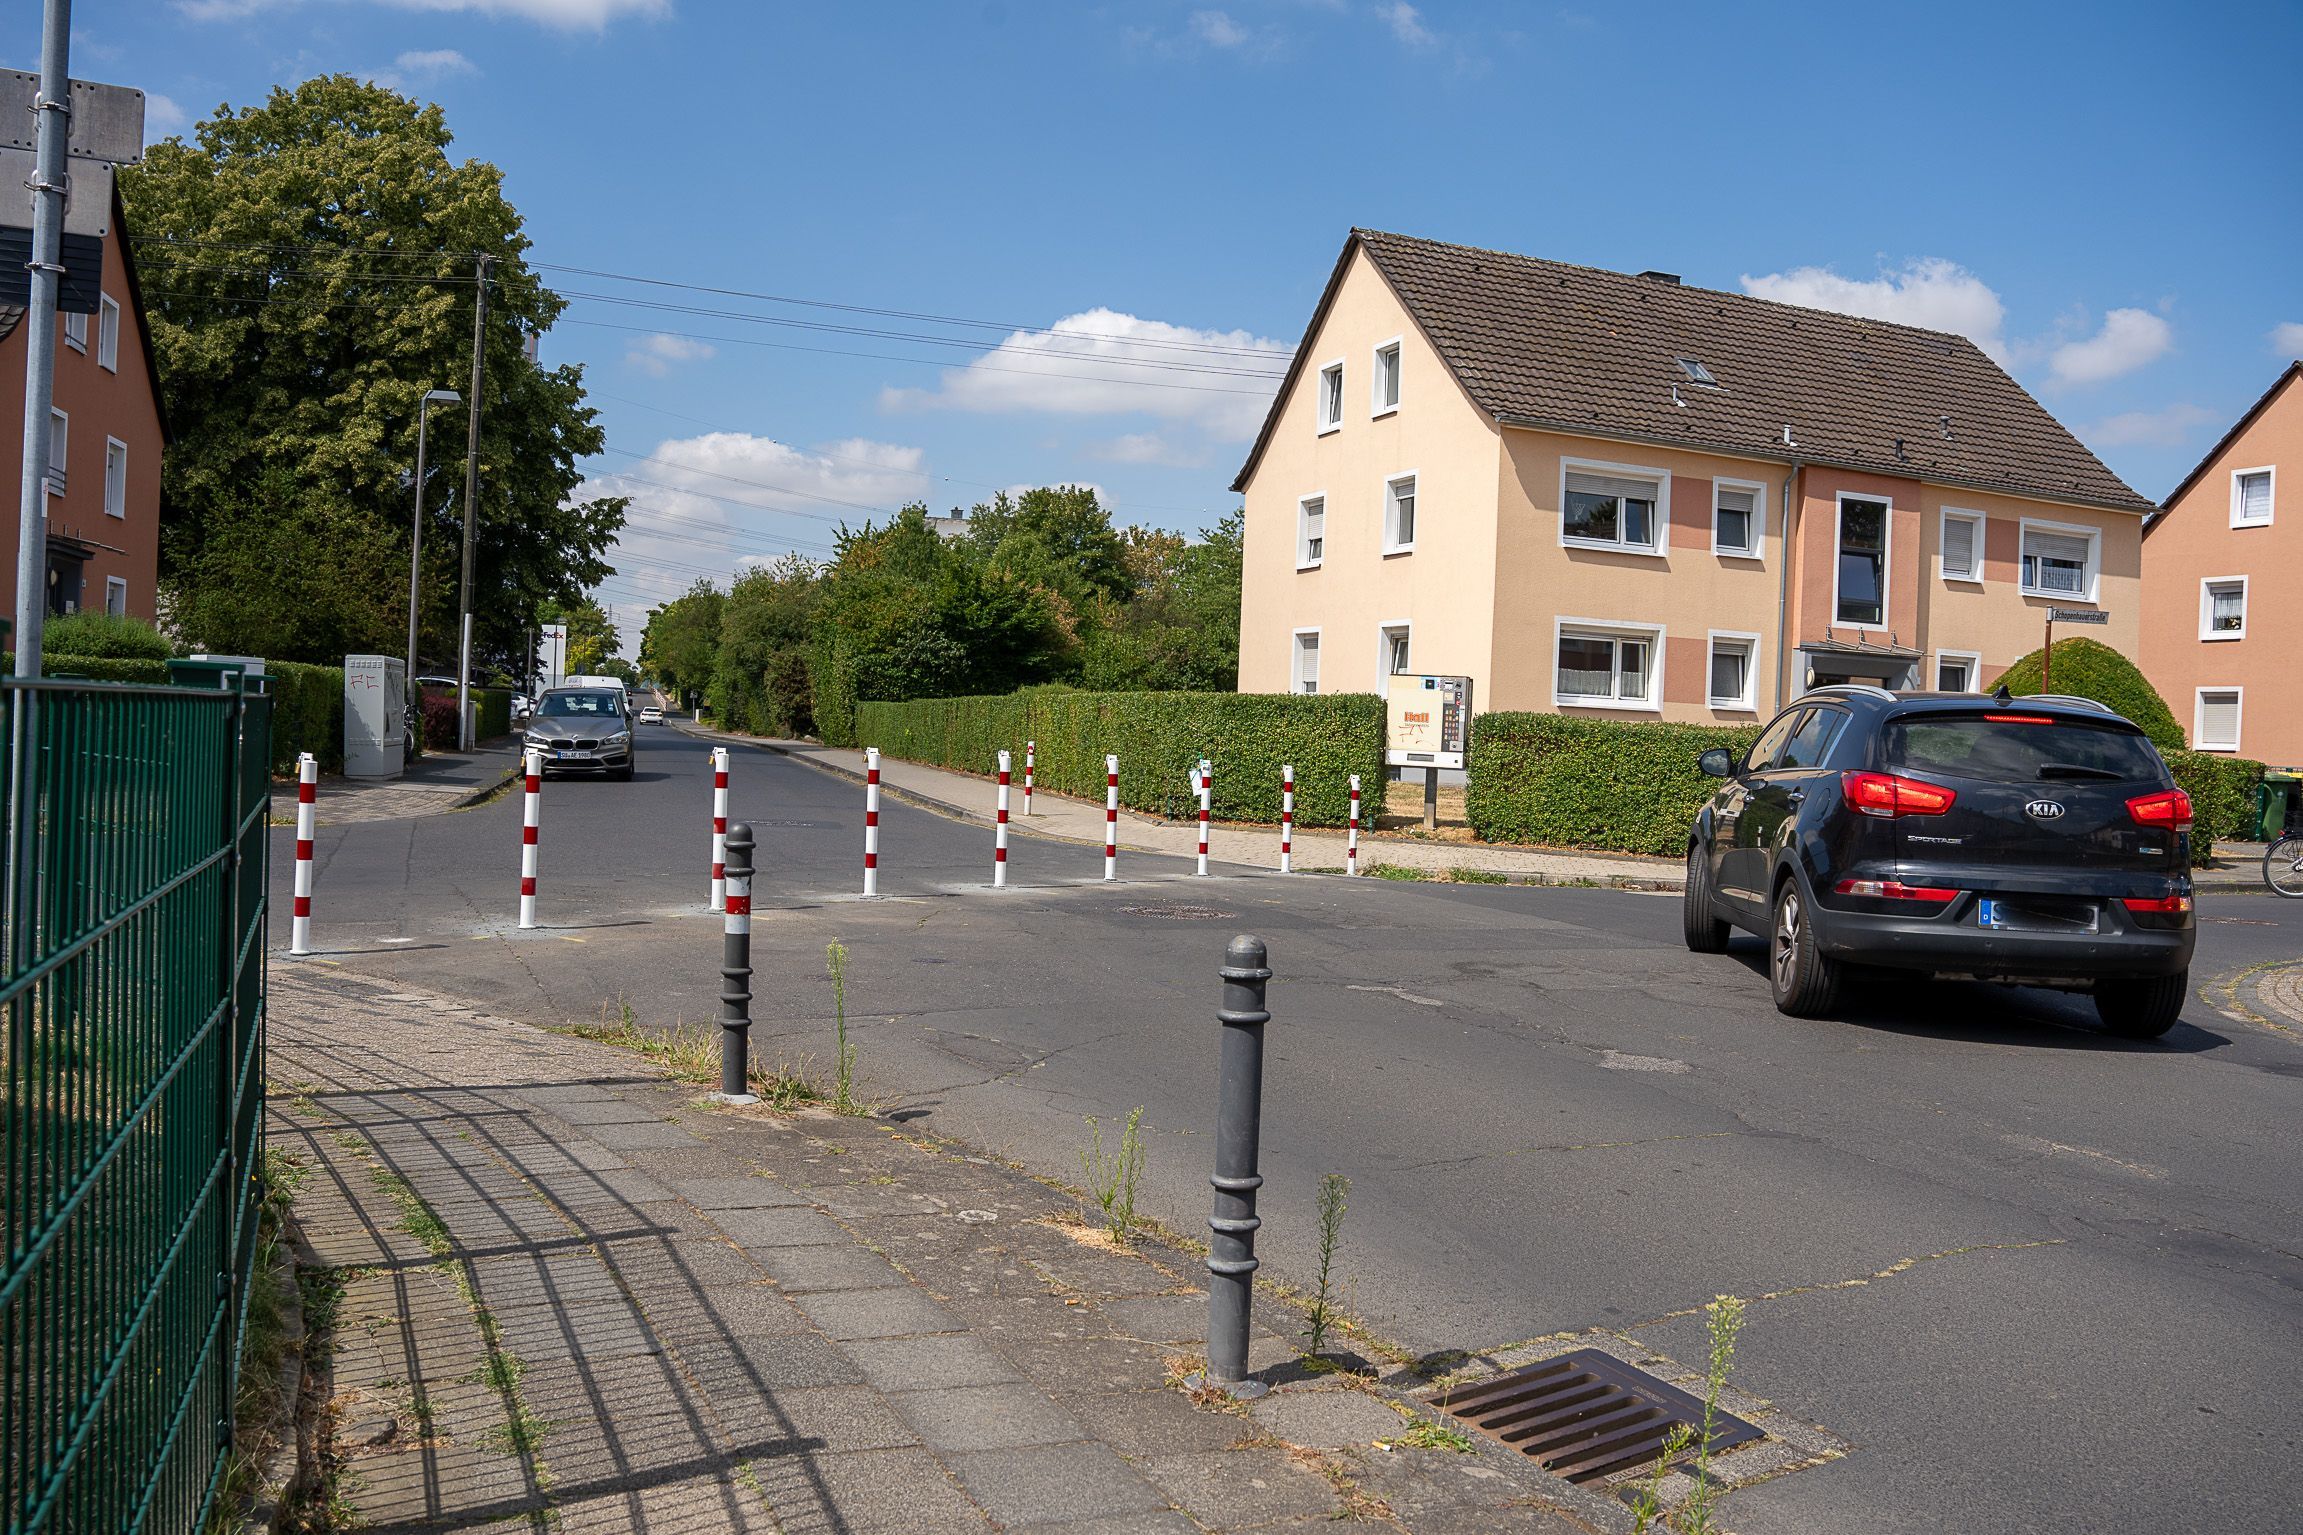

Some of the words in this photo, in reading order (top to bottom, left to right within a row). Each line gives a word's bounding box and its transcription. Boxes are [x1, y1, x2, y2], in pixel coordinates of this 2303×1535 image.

[2055, 610, 2106, 621] Schopenhauerstraße
[2032, 803, 2059, 816] KIA
[1907, 835, 1962, 845] SPORTAGE
